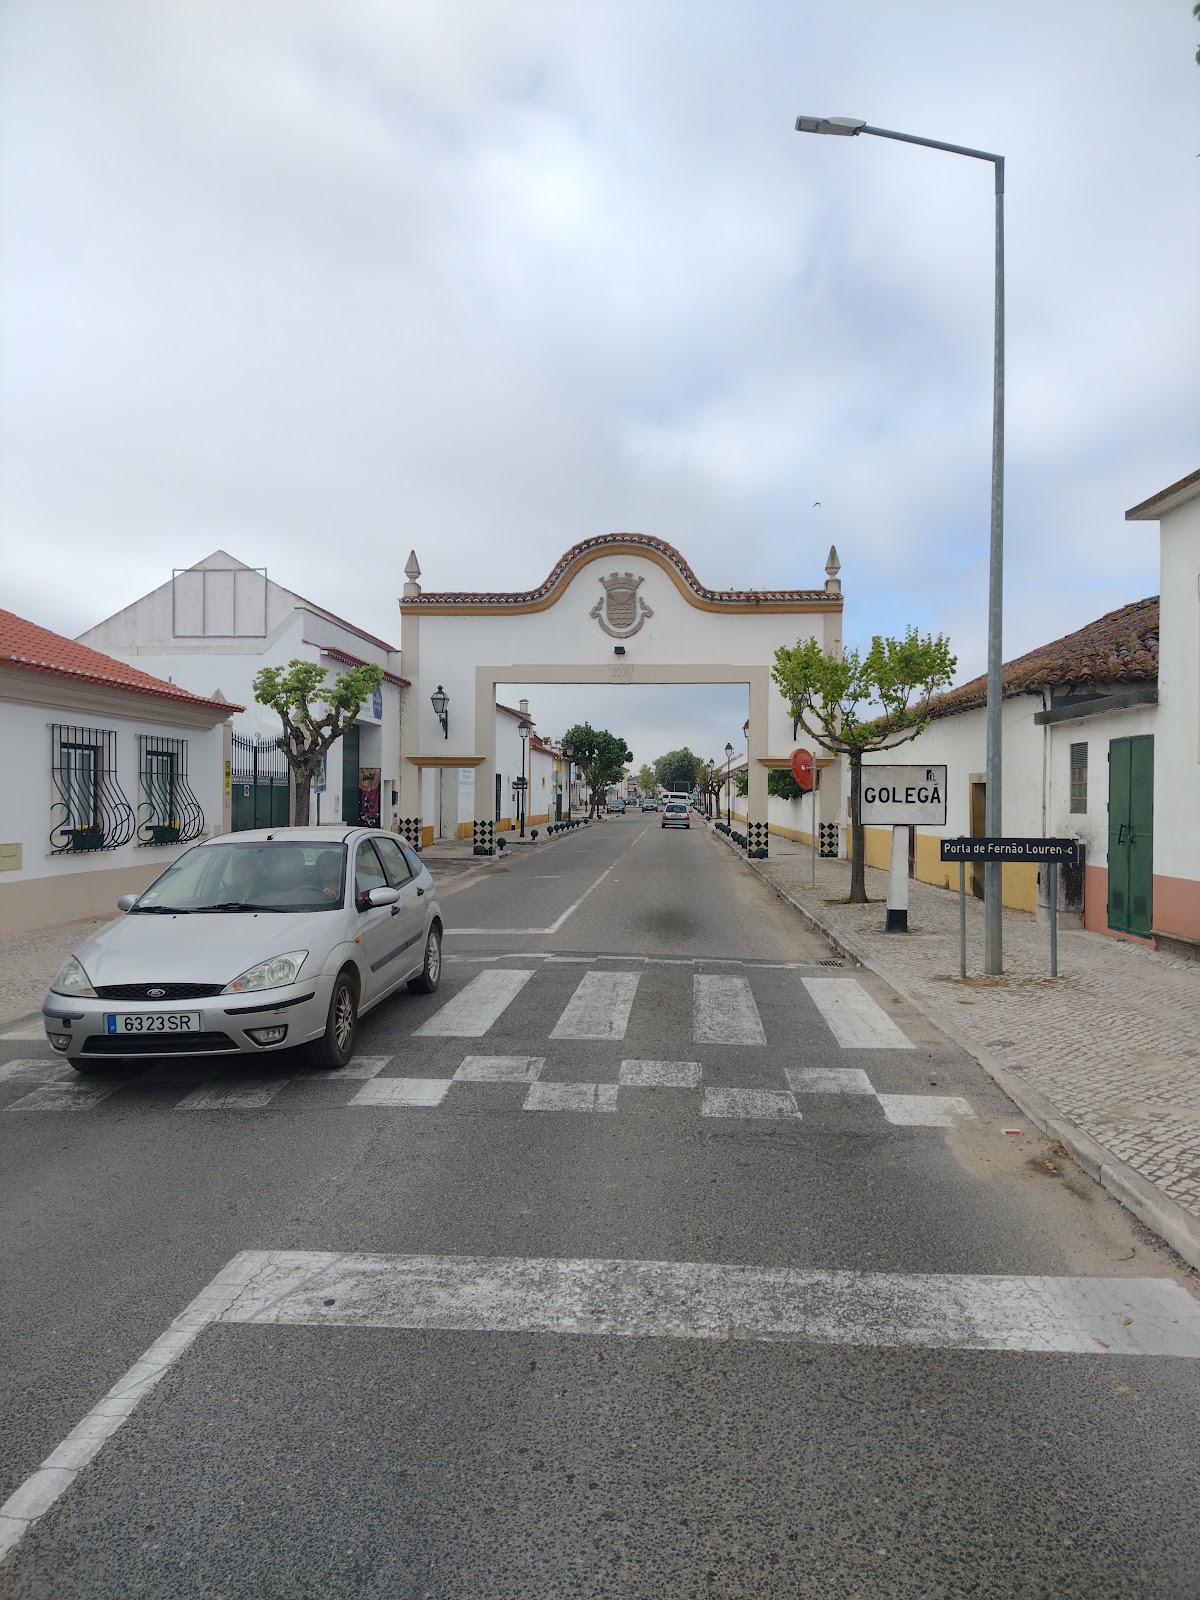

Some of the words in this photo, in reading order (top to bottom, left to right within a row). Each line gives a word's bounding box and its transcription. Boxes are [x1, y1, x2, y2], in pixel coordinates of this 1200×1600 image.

[612, 667, 631, 678] 2008
[973, 844, 986, 854] de
[988, 843, 1024, 854] Fernão
[1026, 844, 1073, 854] Loureno
